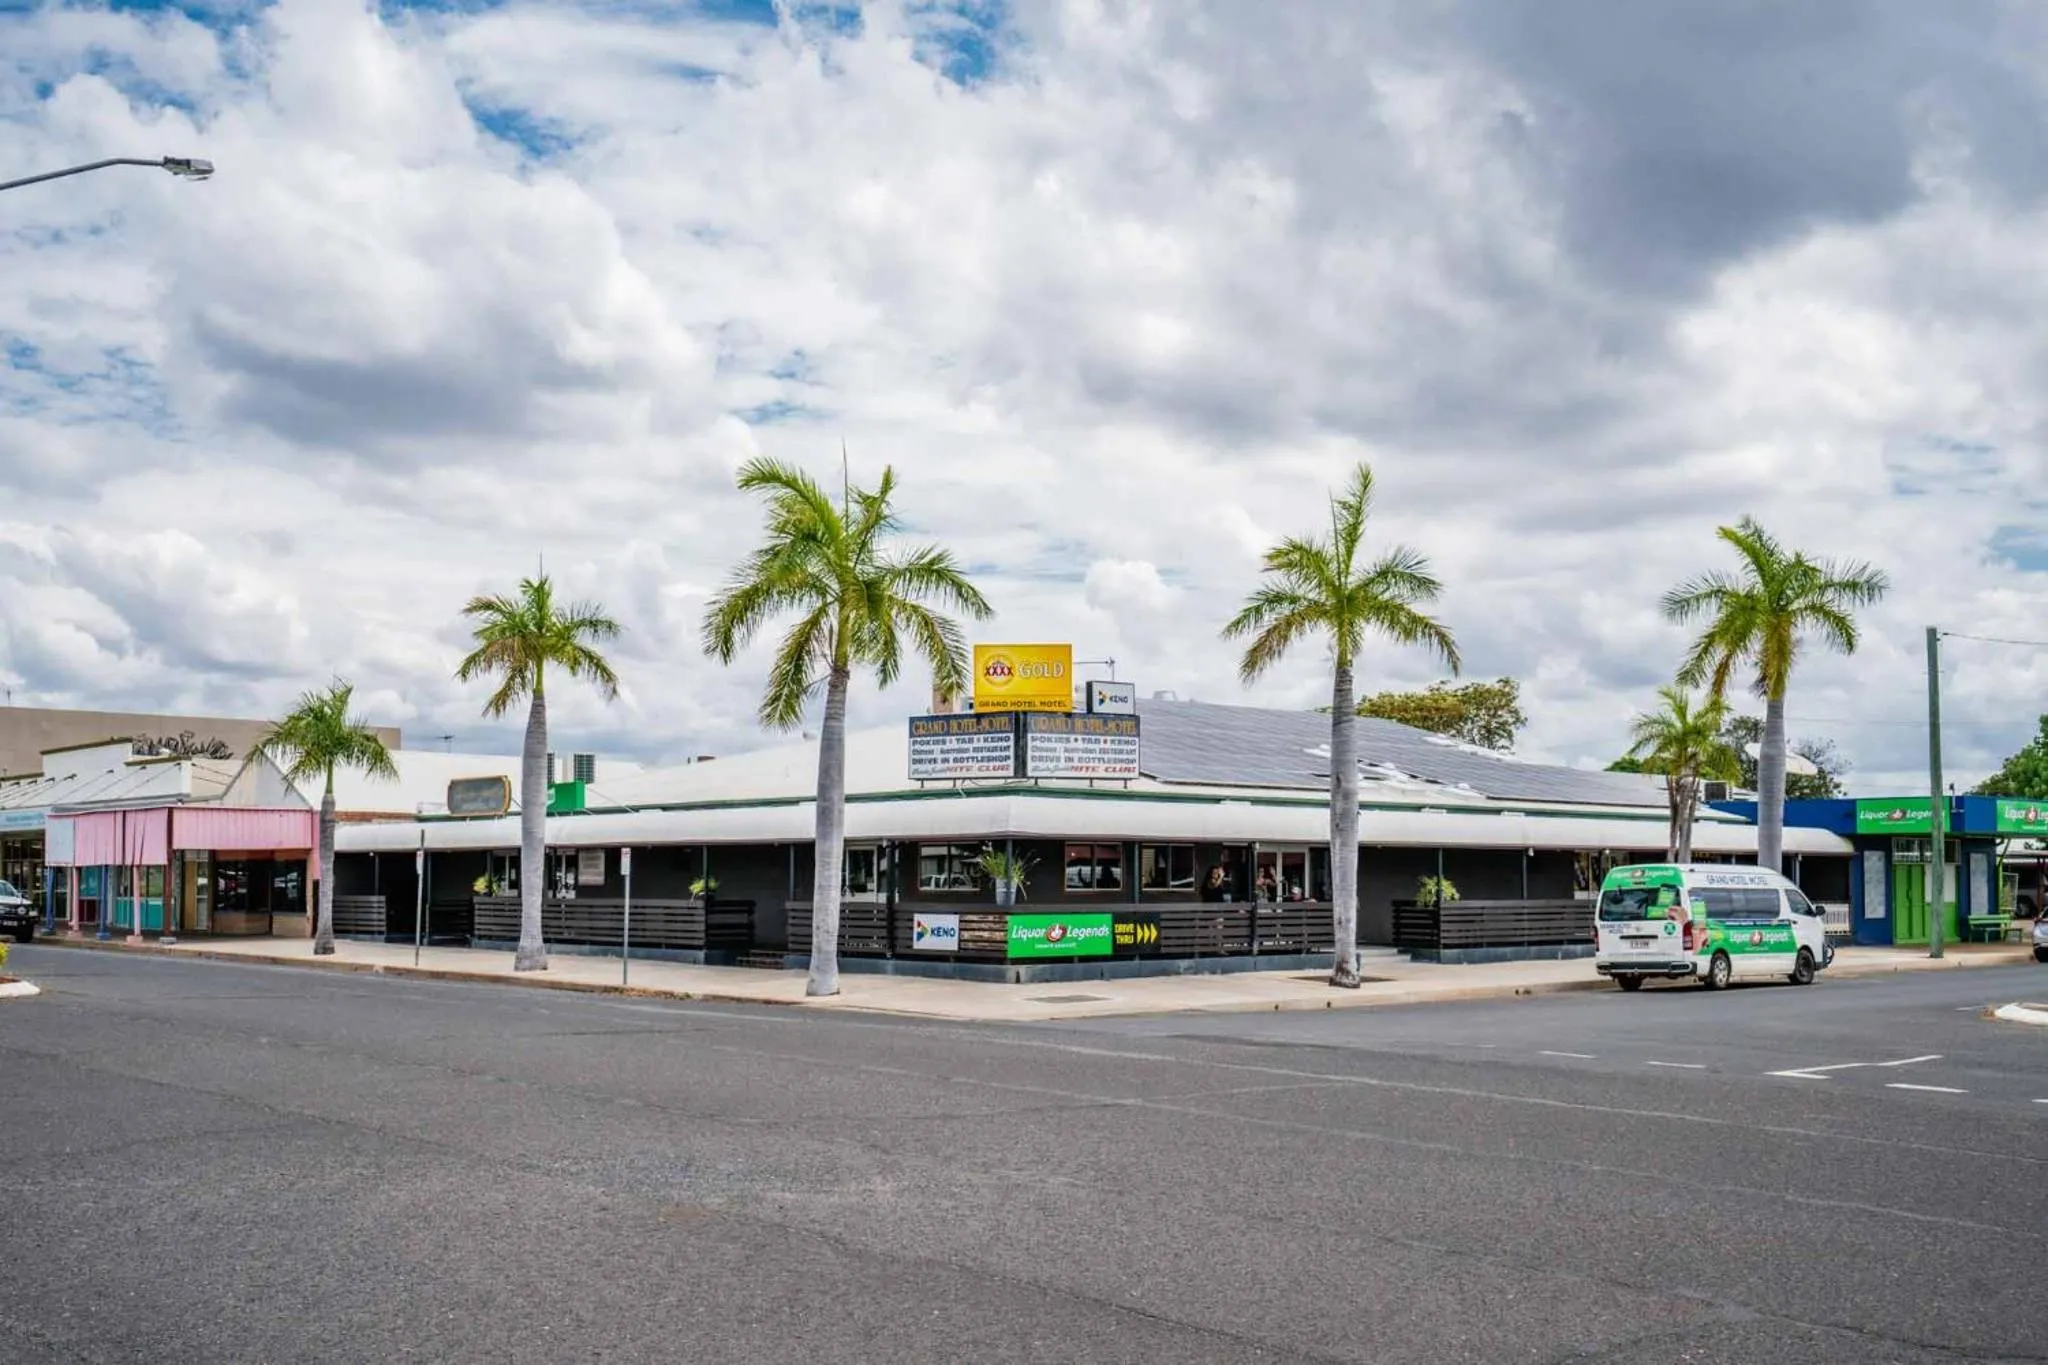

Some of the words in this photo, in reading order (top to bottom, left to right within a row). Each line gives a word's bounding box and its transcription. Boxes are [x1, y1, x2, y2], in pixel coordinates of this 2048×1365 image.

[984, 664, 1015, 677] XXXX
[1019, 661, 1065, 679] GOLD
[978, 700, 1008, 708] GRAND
[1010, 700, 1037, 708] HOTEL
[1039, 700, 1068, 708] MOTEL
[1109, 695, 1129, 704] KENO
[912, 720, 947, 736] GRAND
[912, 738, 947, 746] POKIES
[954, 737, 975, 745] TAB
[982, 735, 1011, 743] KENO
[1030, 735, 1071, 744] POKIES
[1081, 737, 1101, 745] TAB
[1109, 738, 1137, 746] KENO
[911, 757, 939, 765] DRIVE
[952, 755, 1011, 764] BOTTLESHOP
[1030, 755, 1061, 763] DRIVE
[1064, 756, 1075, 764] IN
[1077, 756, 1137, 765] BOTTLESHOP
[1860, 809, 1888, 820] Liquor
[929, 926, 957, 938] KENO
[1011, 924, 1047, 942] Liquor
[1066, 924, 1110, 941] Legends
[1115, 924, 1134, 933] DRIVE
[1116, 935, 1133, 944] THRU
